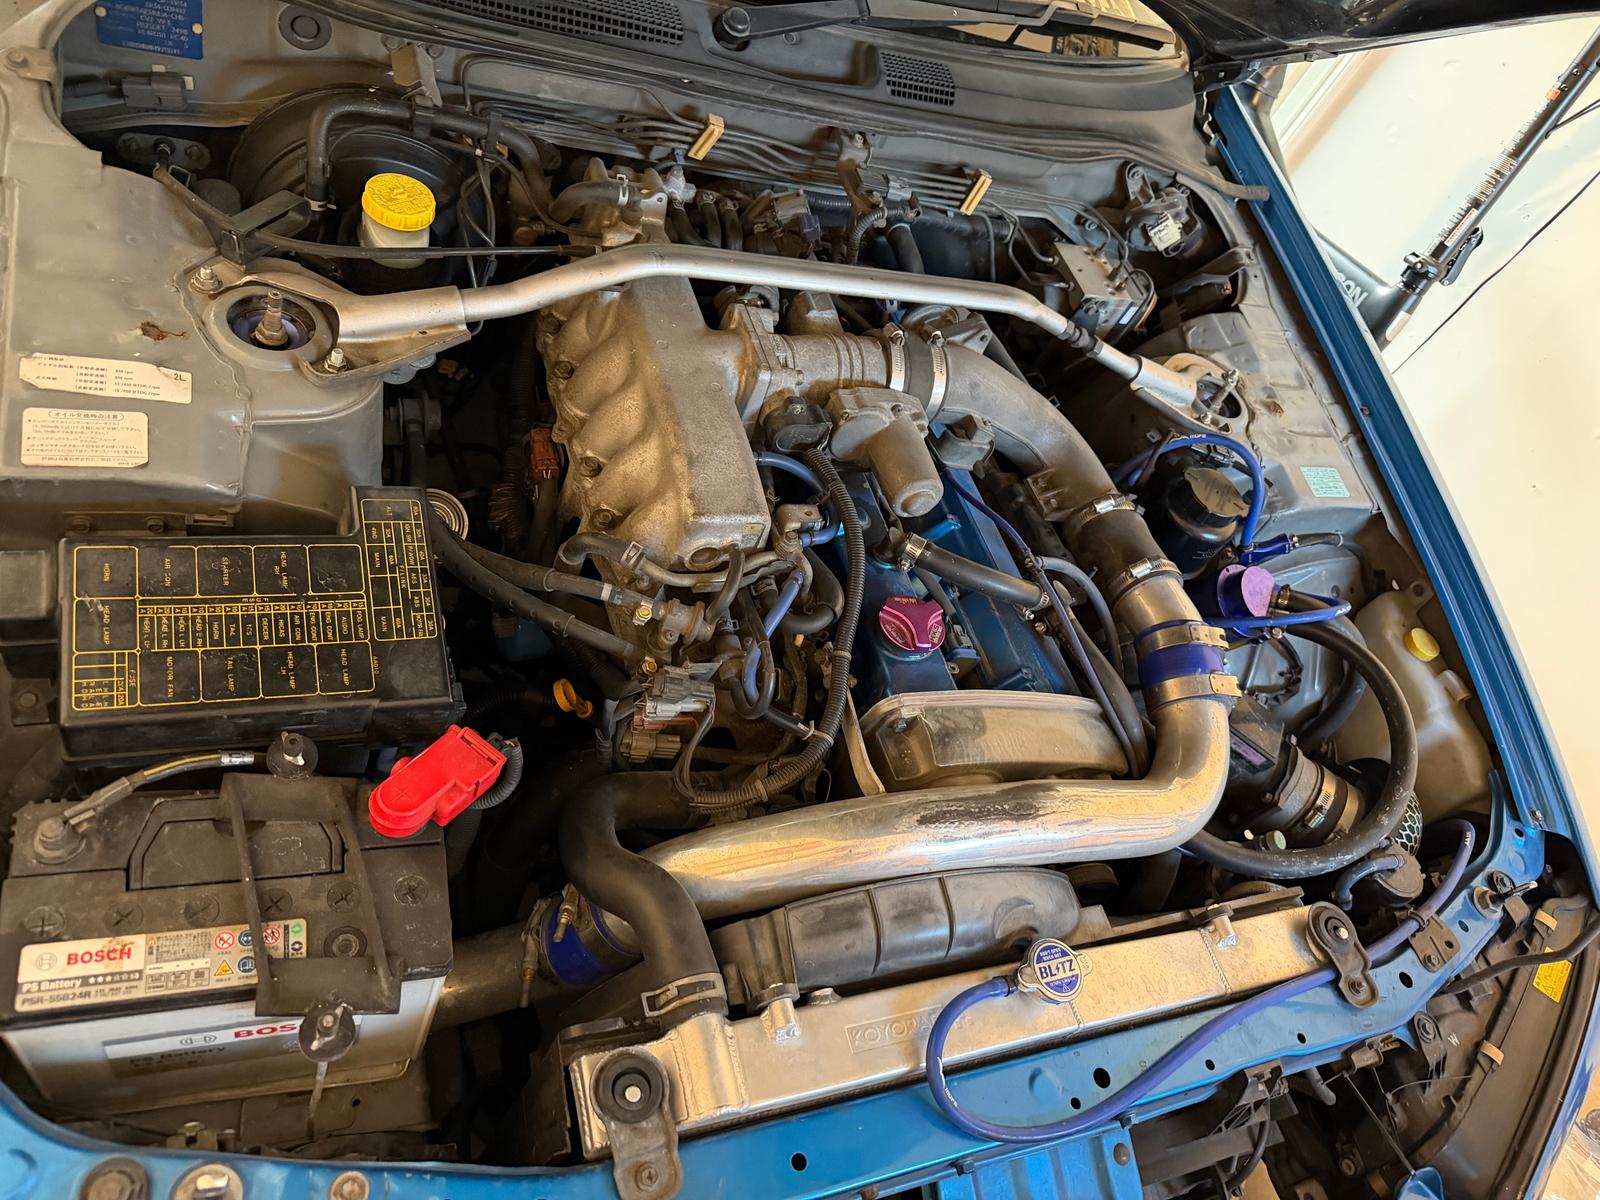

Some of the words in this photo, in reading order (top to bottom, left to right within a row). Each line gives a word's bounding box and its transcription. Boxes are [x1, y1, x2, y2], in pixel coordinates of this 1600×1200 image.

[103, 562, 111, 582] HORN
[221, 556, 230, 586] STARTER
[399, 565, 407, 589] F/LINK
[281, 572, 289, 589] LAMP
[103, 604, 111, 624] HEAD
[261, 617, 269, 640] DEICER
[294, 627, 302, 641] CON
[310, 626, 318, 642] CONT
[326, 625, 334, 641] CONT
[341, 616, 349, 635] AUDIO
[357, 624, 365, 639] LAMP
[103, 626, 111, 645] LAMP
[287, 651, 295, 669] HEAD
[340, 648, 348, 666] HEAD
[166, 656, 174, 681] MOTOR
[342, 668, 350, 686] LAMP
[227, 673, 235, 692] LAMP
[288, 671, 296, 690] LAMP
[167, 683, 175, 698] FAN
[66, 947, 132, 966] BOSCH
[1040, 949, 1051, 957] DON'T
[22, 982, 39, 994] PS
[40, 978, 82, 991] Battery
[234, 1023, 297, 1039] BOS
